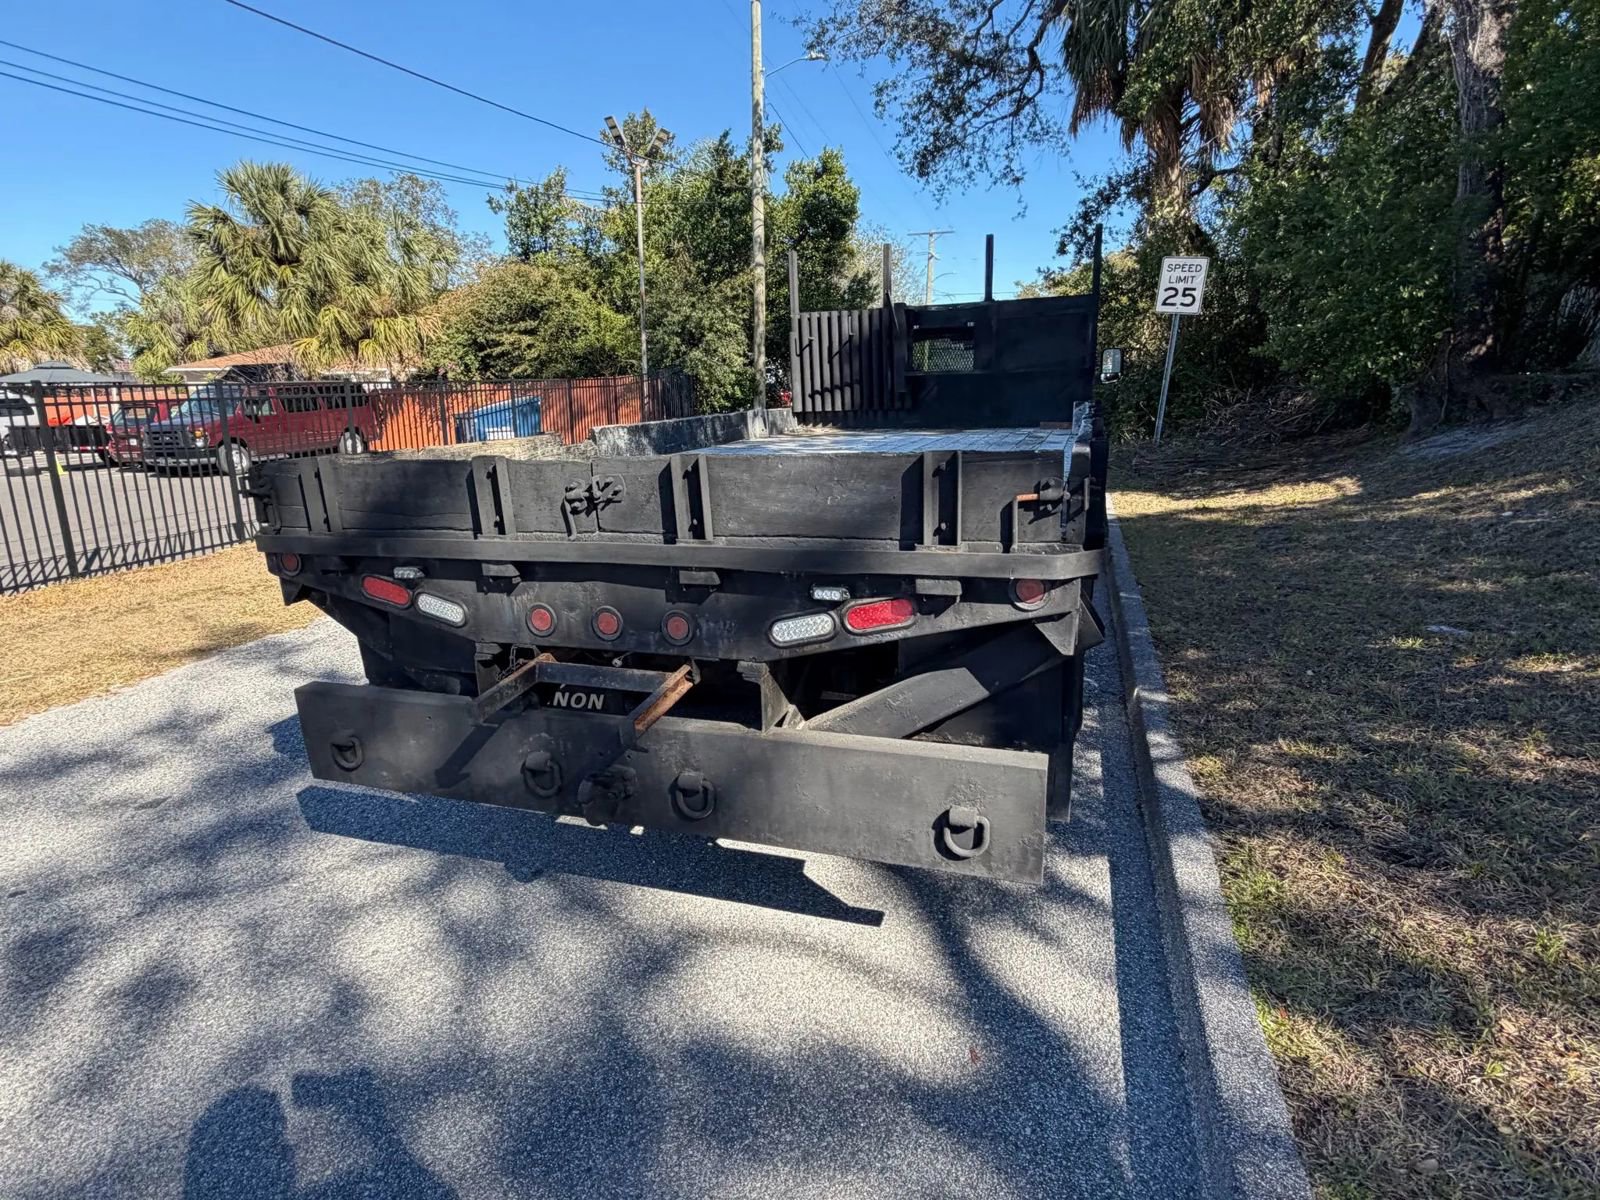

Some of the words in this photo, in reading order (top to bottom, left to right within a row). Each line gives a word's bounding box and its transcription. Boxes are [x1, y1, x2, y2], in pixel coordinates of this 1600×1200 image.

[1166, 263, 1203, 273] SPEED
[1168, 275, 1196, 284] LIMIT
[1161, 286, 1197, 307] 25
[547, 691, 605, 710] NON
